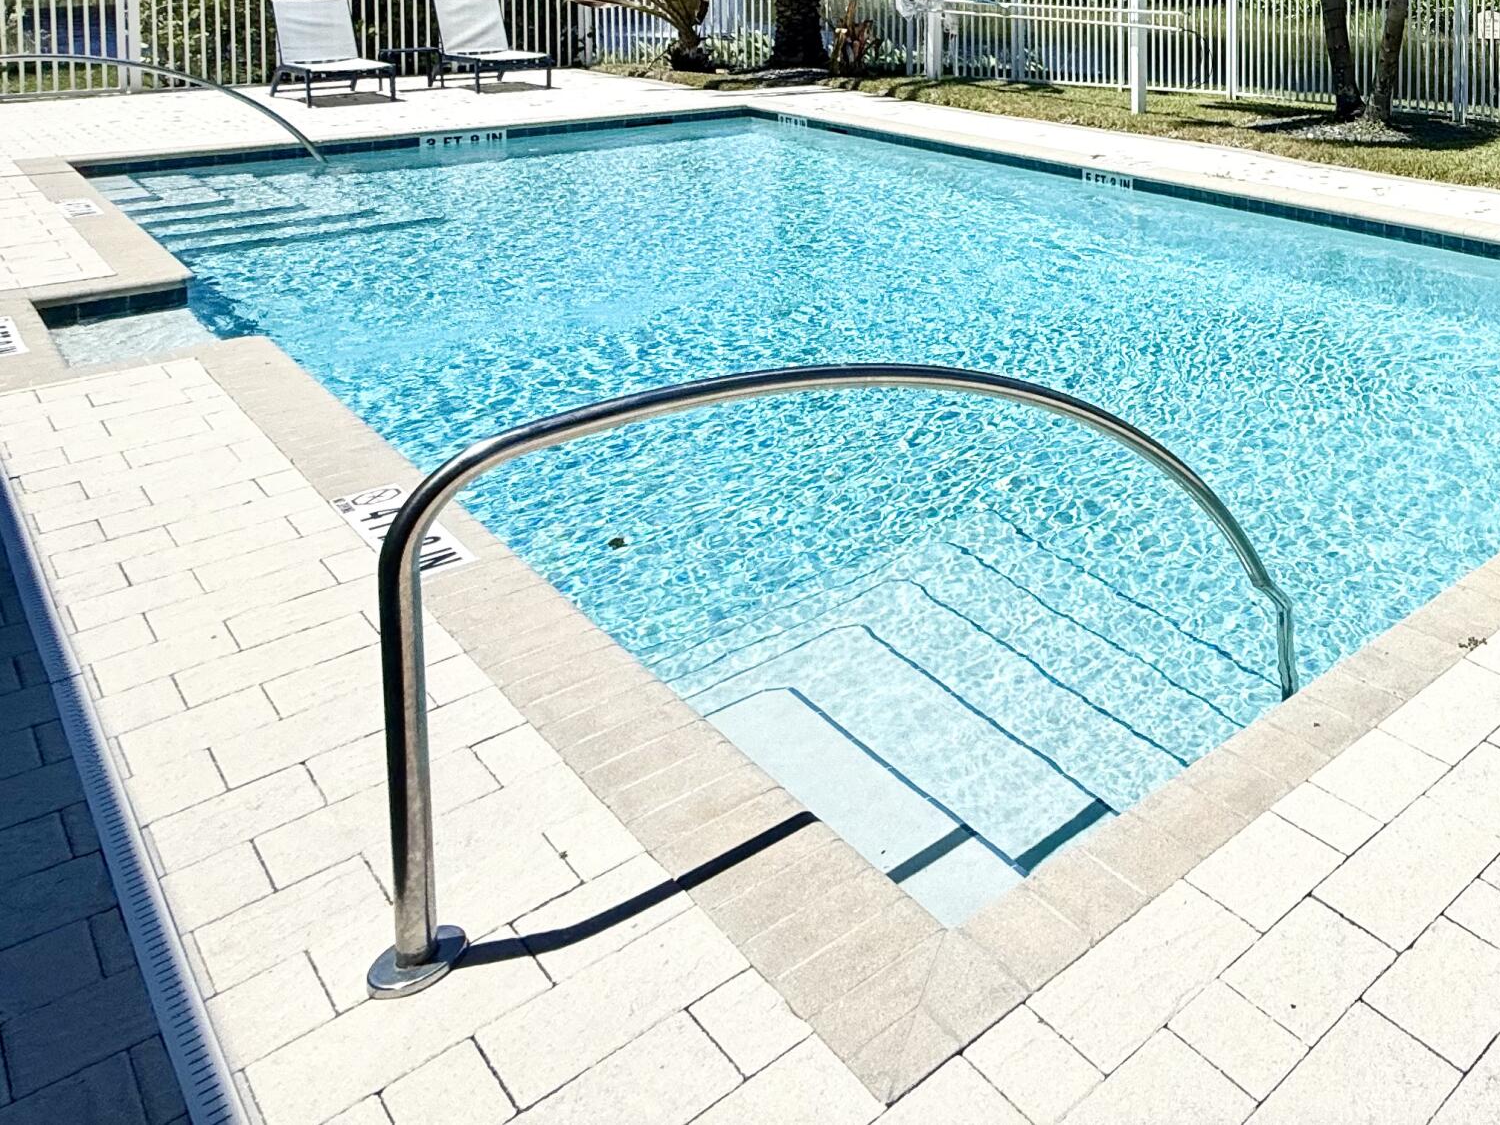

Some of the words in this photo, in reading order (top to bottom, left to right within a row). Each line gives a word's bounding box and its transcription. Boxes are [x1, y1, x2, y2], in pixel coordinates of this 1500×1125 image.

[443, 136, 463, 145] FT
[487, 132, 503, 141] IN
[1120, 179, 1130, 189] IN
